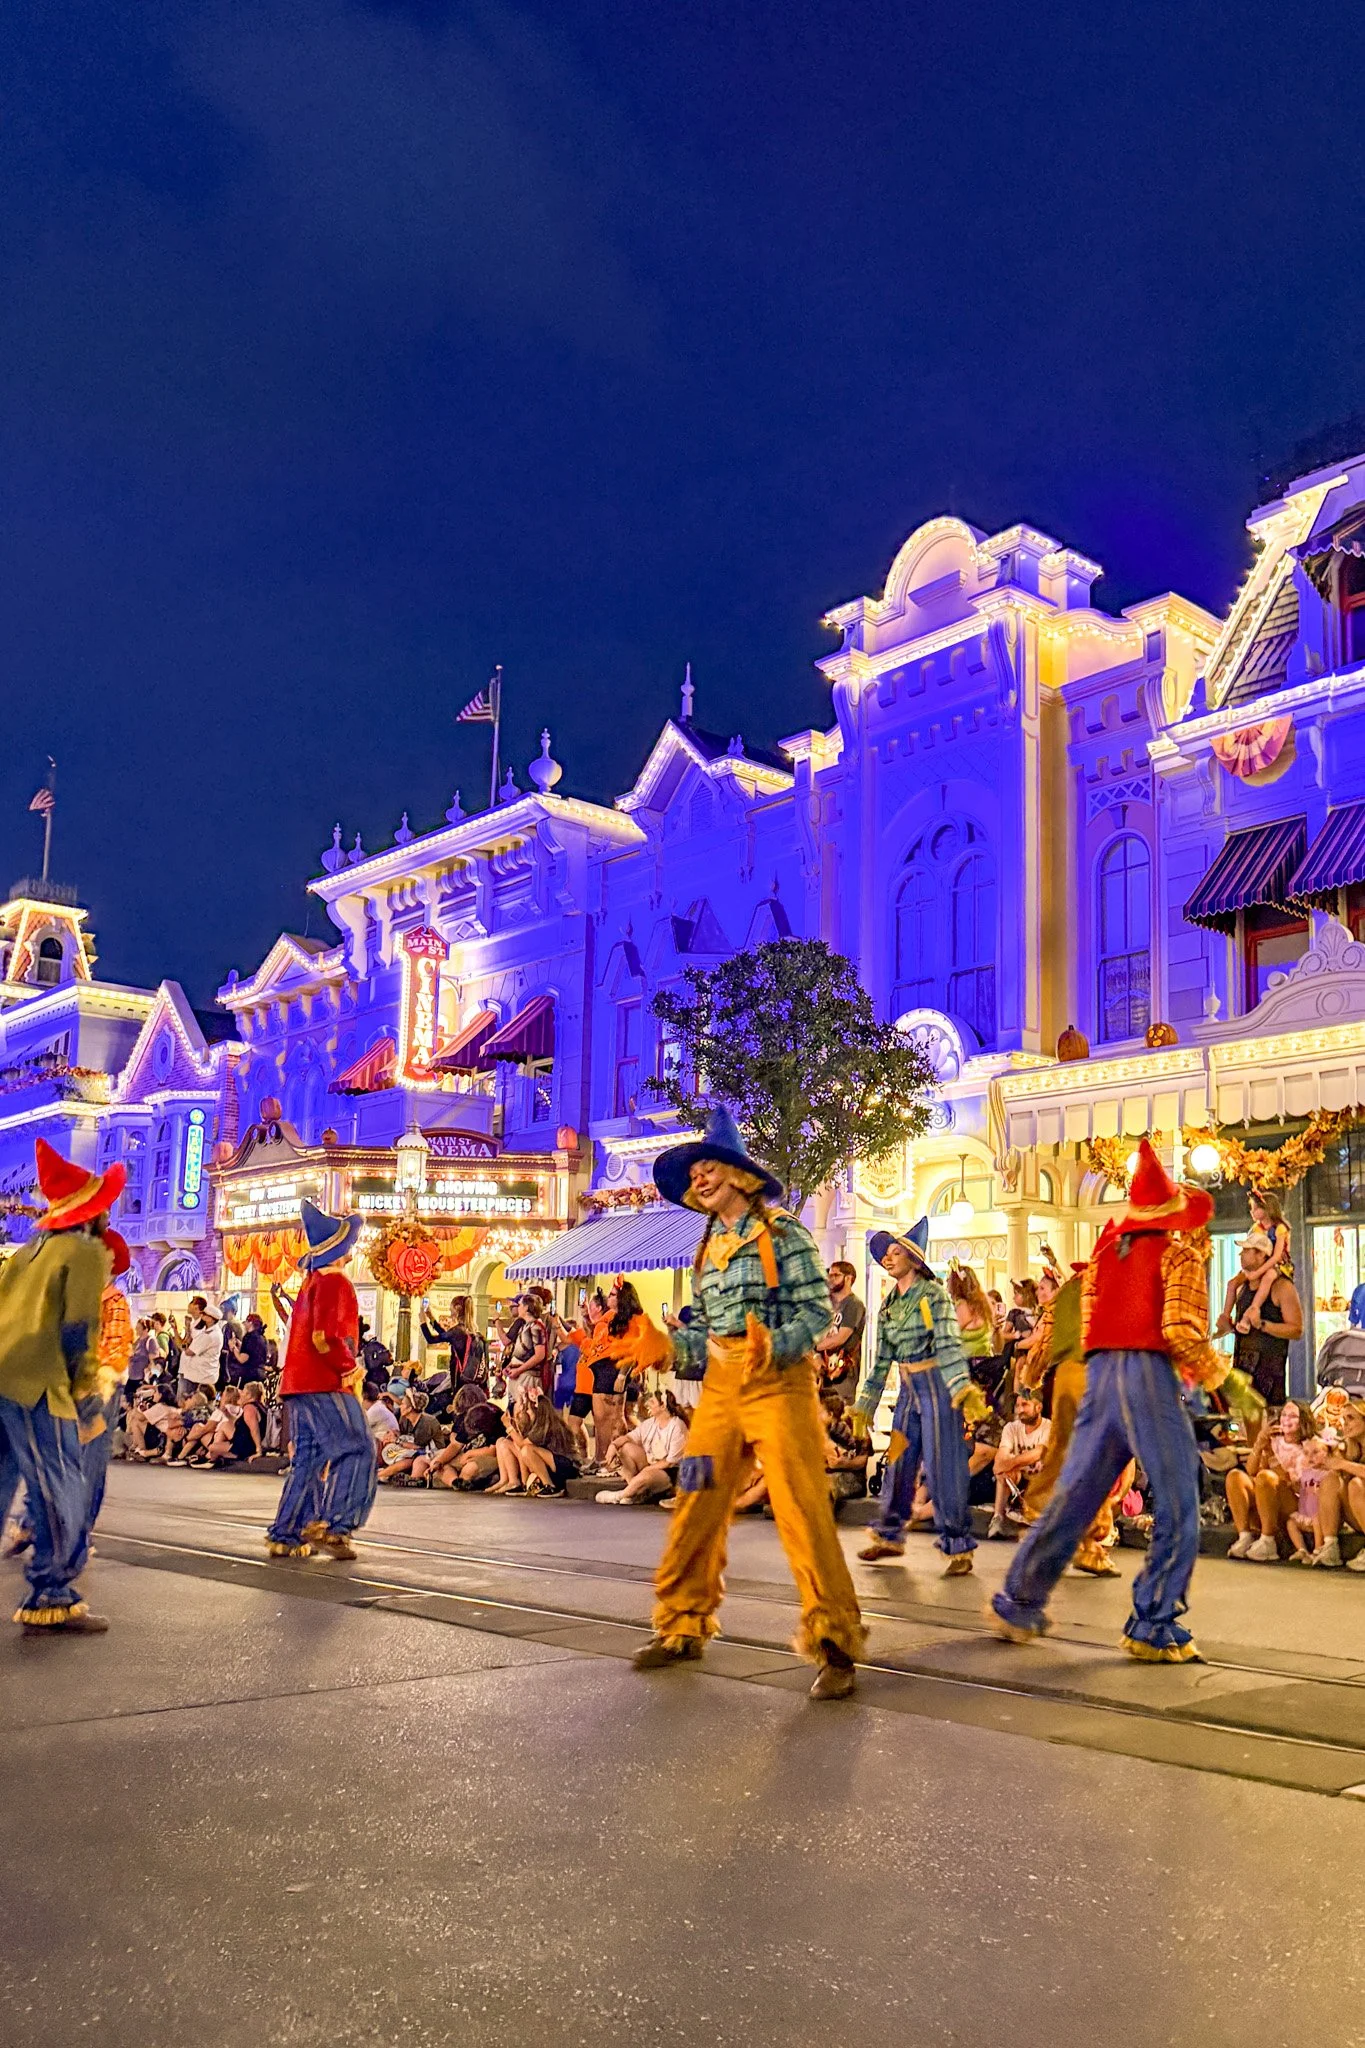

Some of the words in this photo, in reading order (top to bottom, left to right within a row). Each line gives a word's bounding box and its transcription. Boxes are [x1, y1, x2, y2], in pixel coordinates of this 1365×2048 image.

[407, 937, 443, 949] MAIN
[411, 957, 436, 1065] CINEMA
[427, 1137, 456, 1146] MAIN
[458, 1137, 472, 1145] ST
[429, 1144, 493, 1158] NEMA
[435, 1180, 498, 1195] SHOWING
[417, 1195, 532, 1212] MOUSETERPIECES
